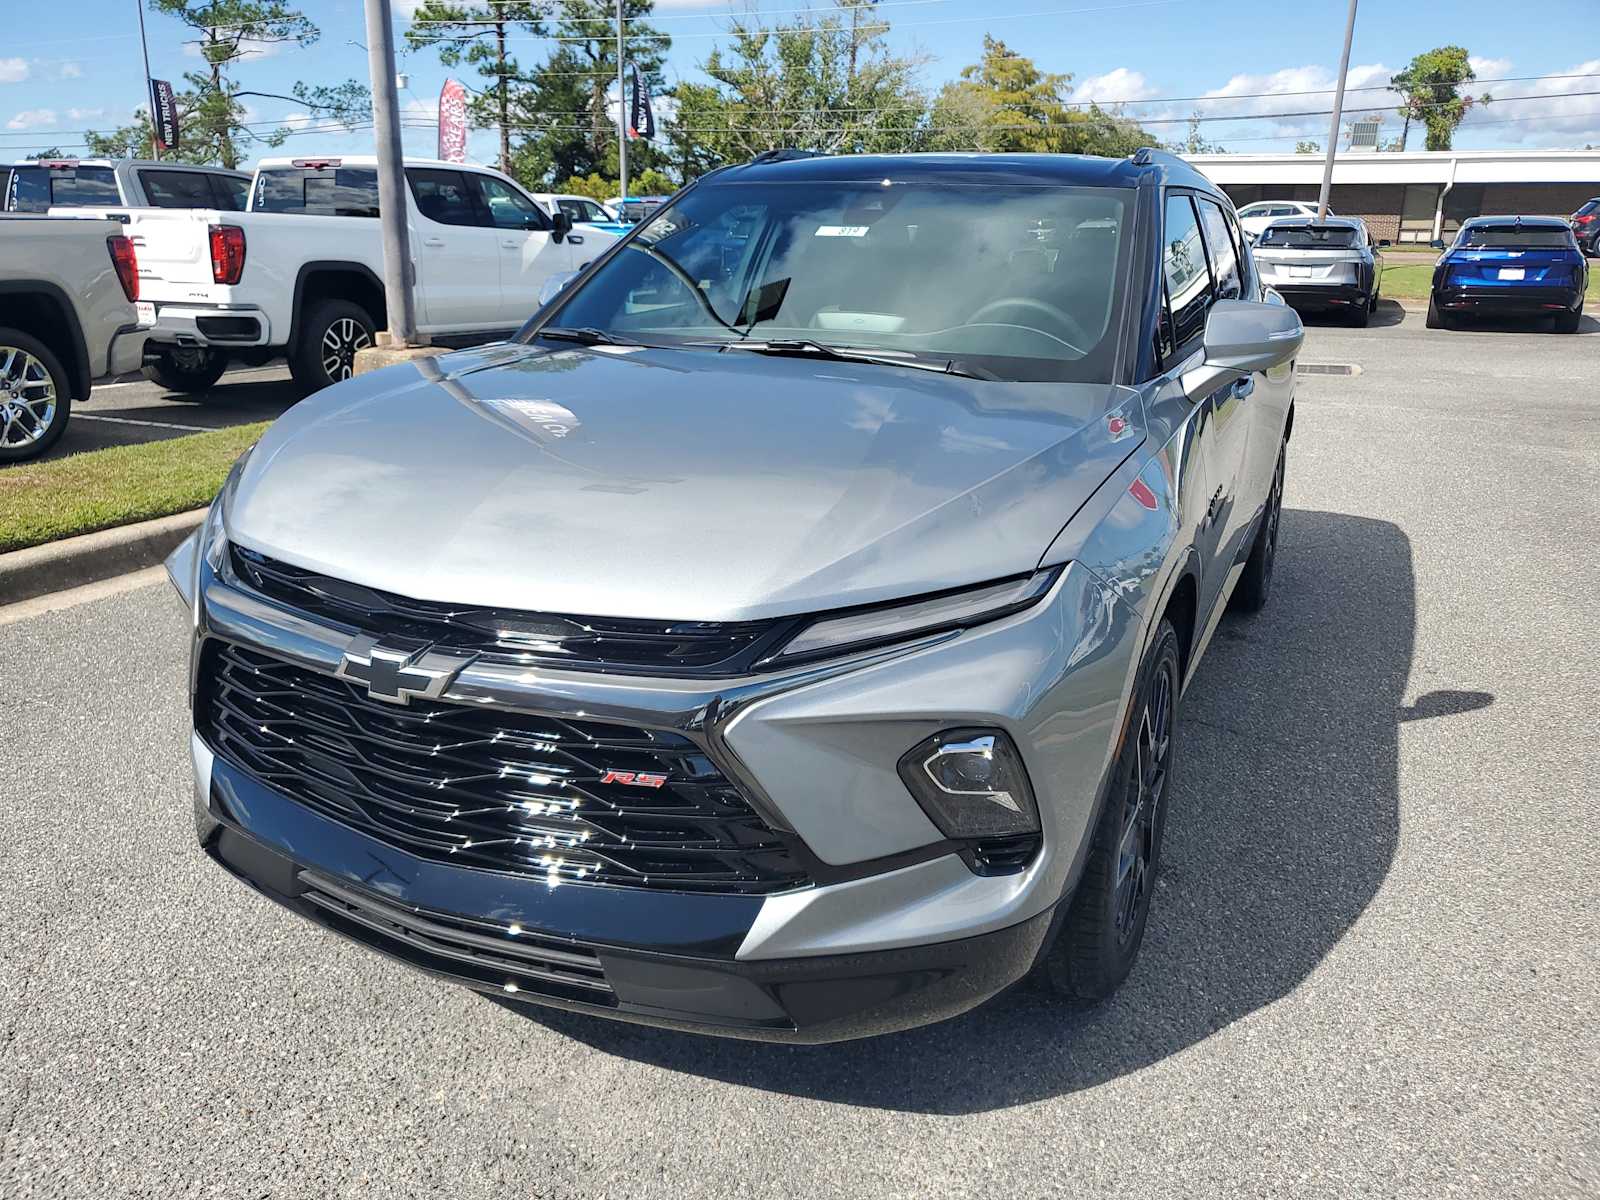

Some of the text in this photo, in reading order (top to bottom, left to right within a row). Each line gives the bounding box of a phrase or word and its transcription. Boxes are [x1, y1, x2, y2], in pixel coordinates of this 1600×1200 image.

[158, 83, 173, 146] NEW TRUCKS
[637, 105, 648, 133] NEW
[601, 769, 667, 788] RS
